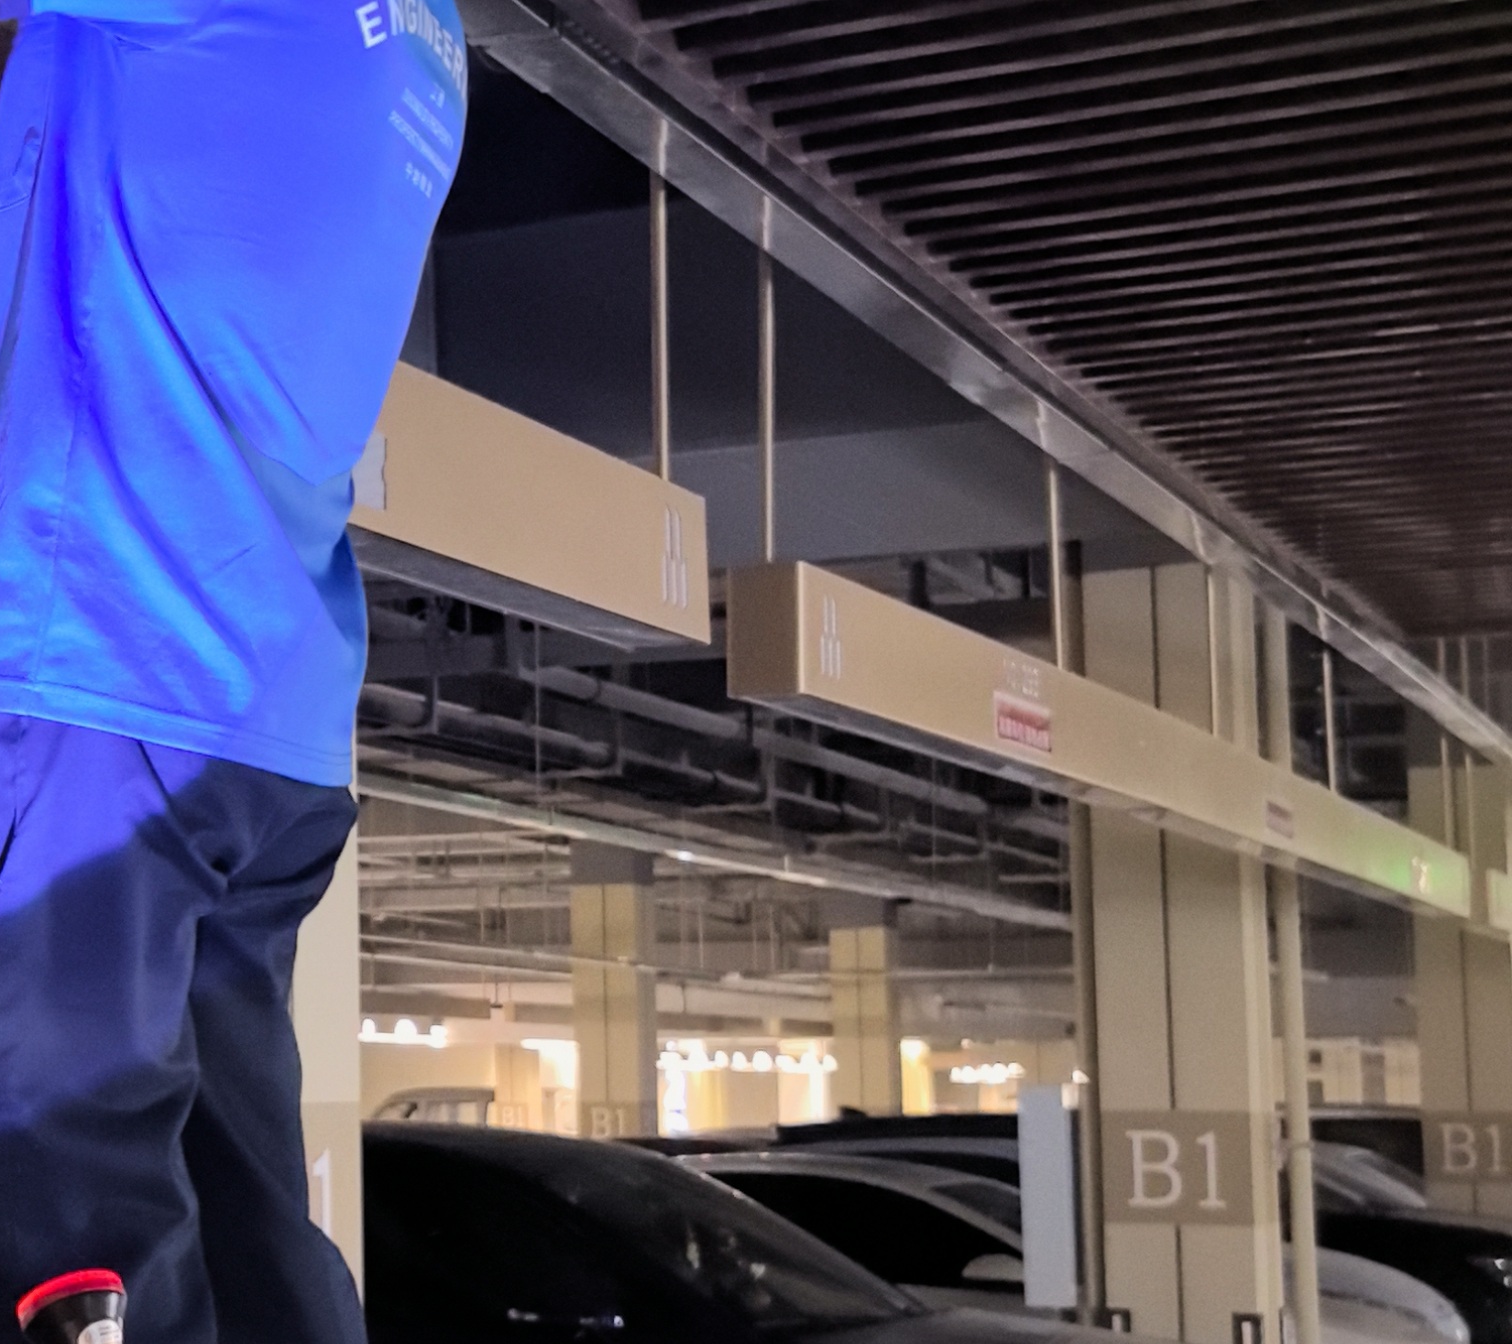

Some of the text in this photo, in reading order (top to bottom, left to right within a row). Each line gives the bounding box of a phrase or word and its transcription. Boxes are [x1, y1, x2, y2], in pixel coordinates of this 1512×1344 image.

[591, 1106, 626, 1140] B1
[1441, 1122, 1512, 1173] B1
[1125, 1129, 1227, 1209] B1
